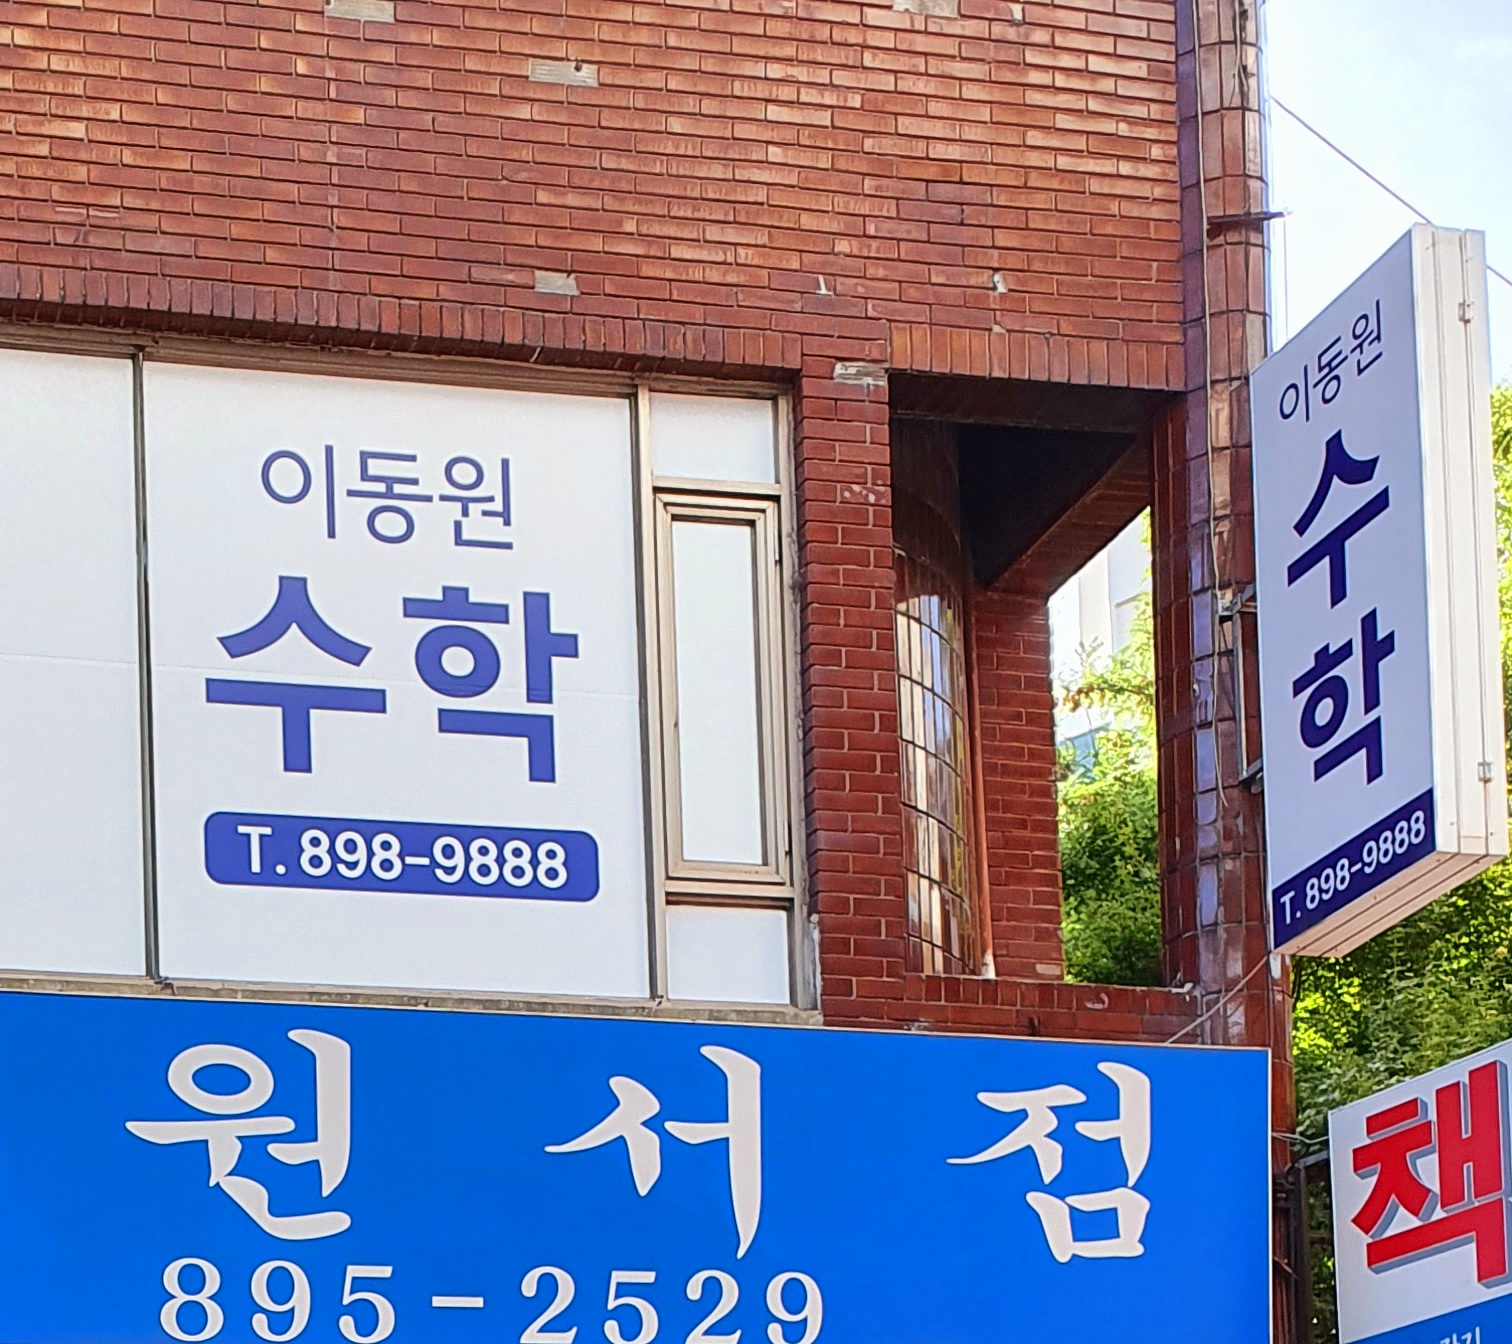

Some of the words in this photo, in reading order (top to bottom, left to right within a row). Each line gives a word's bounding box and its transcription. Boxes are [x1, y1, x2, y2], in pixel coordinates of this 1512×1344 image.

[1278, 298, 1383, 424] 이동원
[261, 444, 514, 550] 이동원
[204, 575, 580, 784] 수학
[1287, 428, 1396, 786] 수학
[1352, 1058, 1510, 1290] 책
